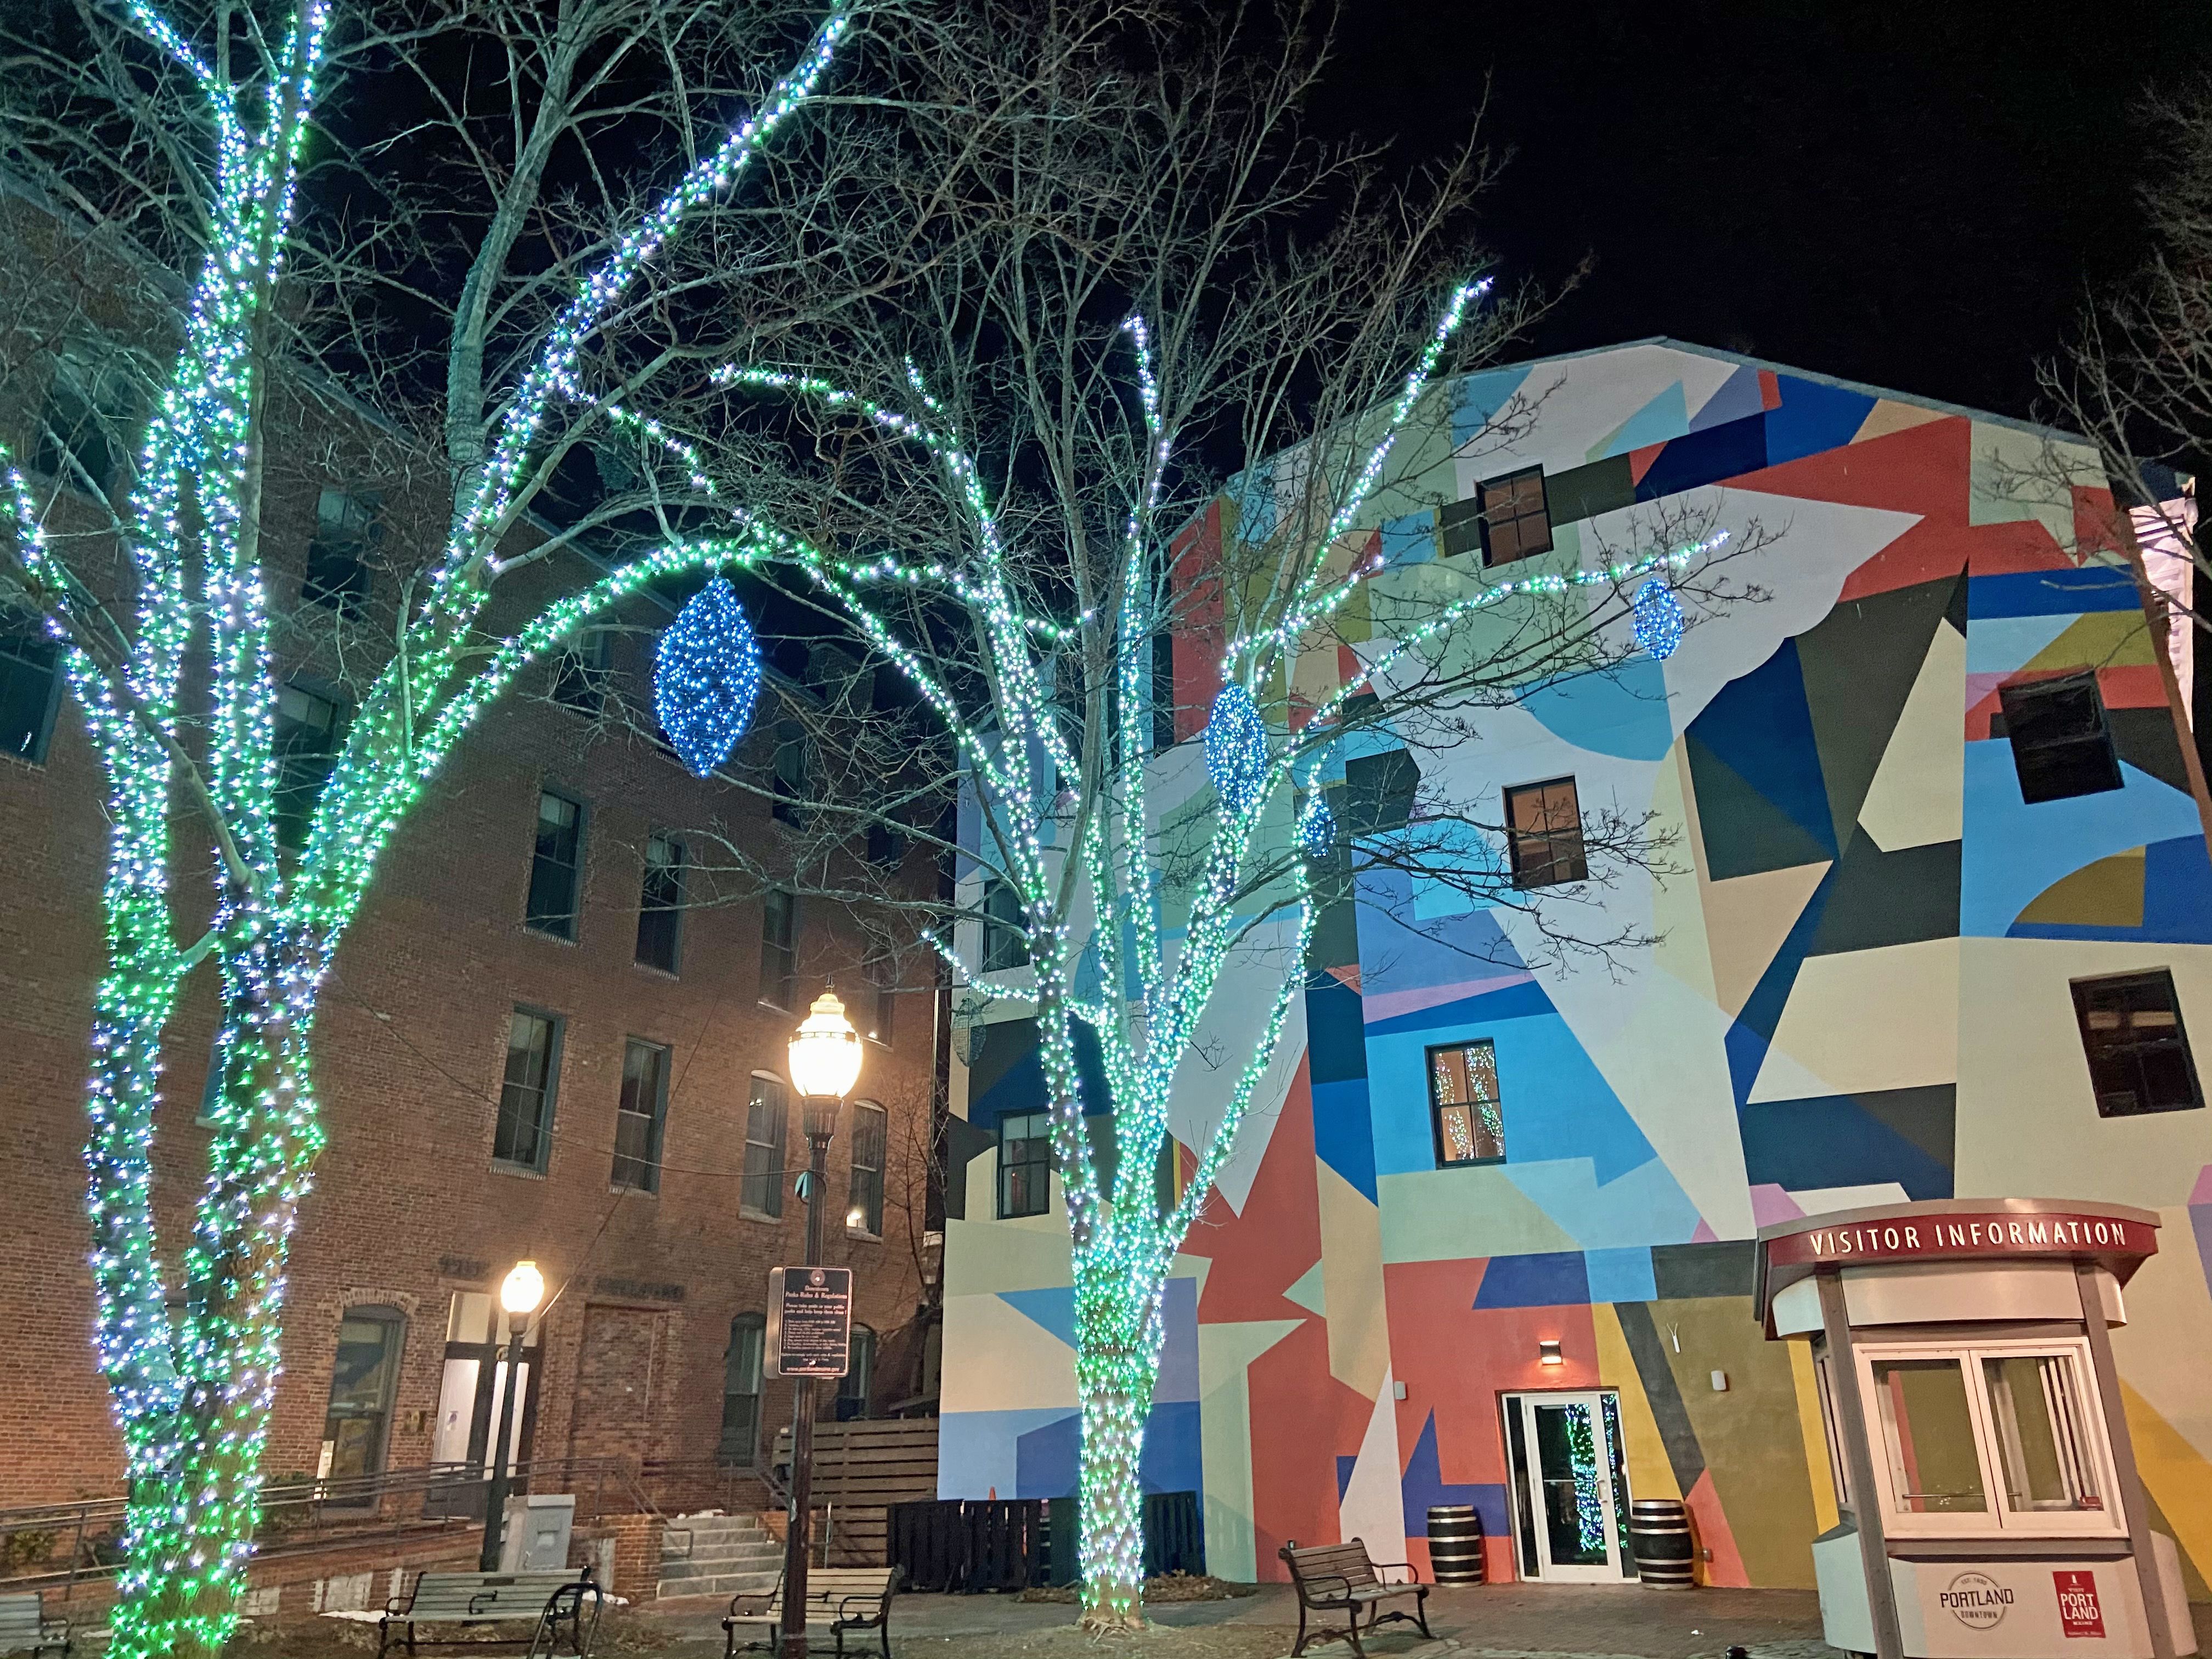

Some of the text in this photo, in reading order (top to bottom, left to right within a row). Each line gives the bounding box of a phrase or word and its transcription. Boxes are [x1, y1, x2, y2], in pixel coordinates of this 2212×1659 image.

[1810, 1222, 2126, 1255] VISITOR INFORMATION
[1940, 1589, 2014, 1608] PORTLAND
[2060, 1593, 2094, 1607] PORT
[2063, 1606, 2098, 1620] LAND
